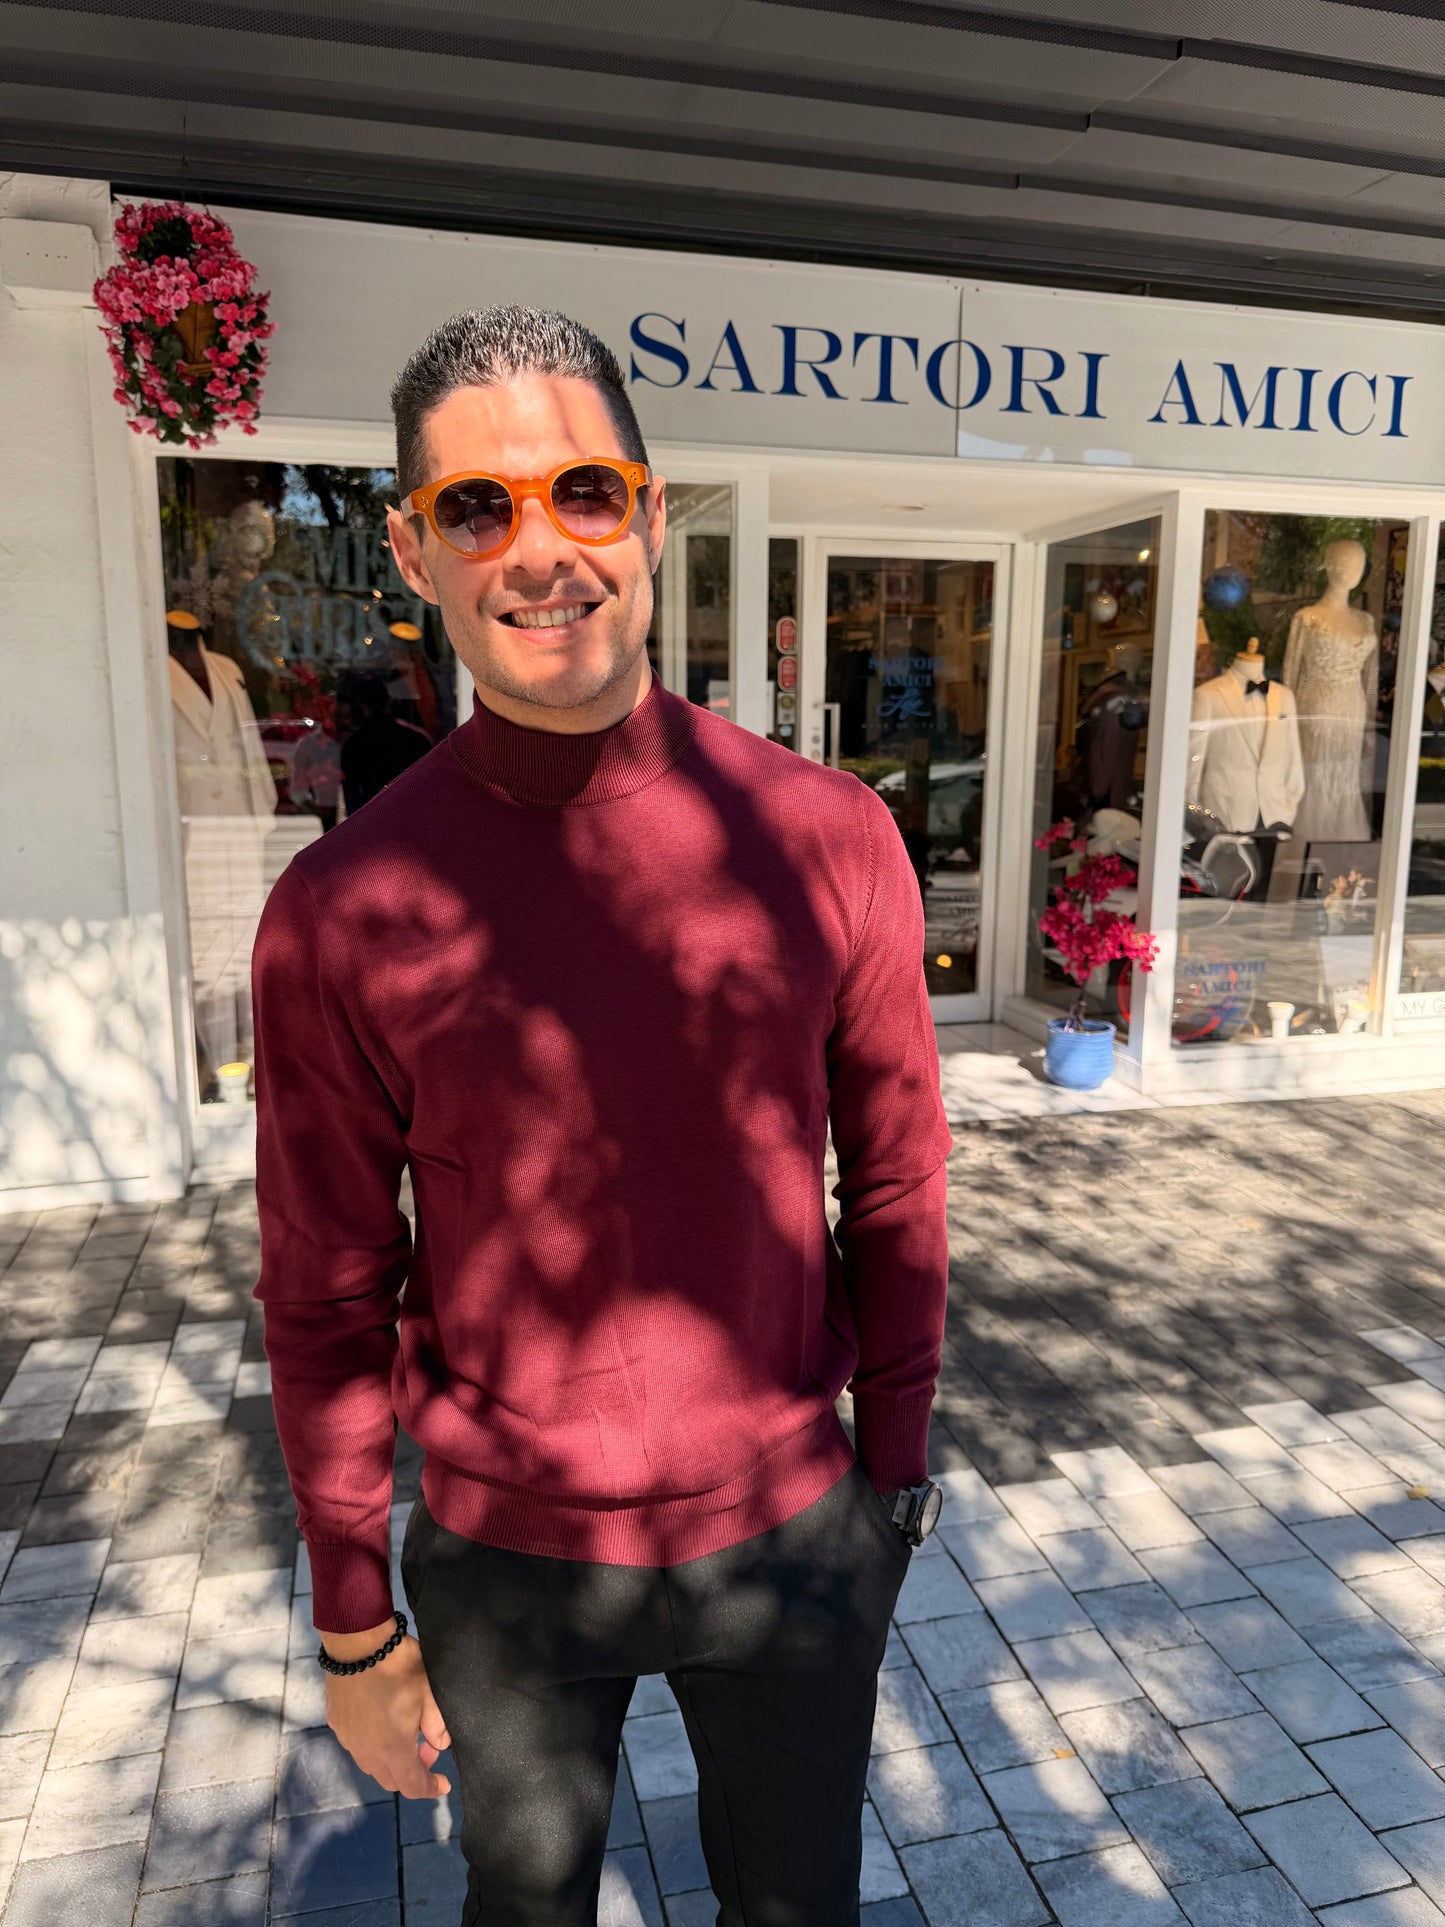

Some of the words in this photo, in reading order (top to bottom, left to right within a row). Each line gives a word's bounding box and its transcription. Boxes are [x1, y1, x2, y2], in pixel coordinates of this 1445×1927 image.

[629, 312, 1110, 419] SARTORI
[1147, 358, 1414, 438] AMICI
[1401, 1000, 1426, 1017] MY
